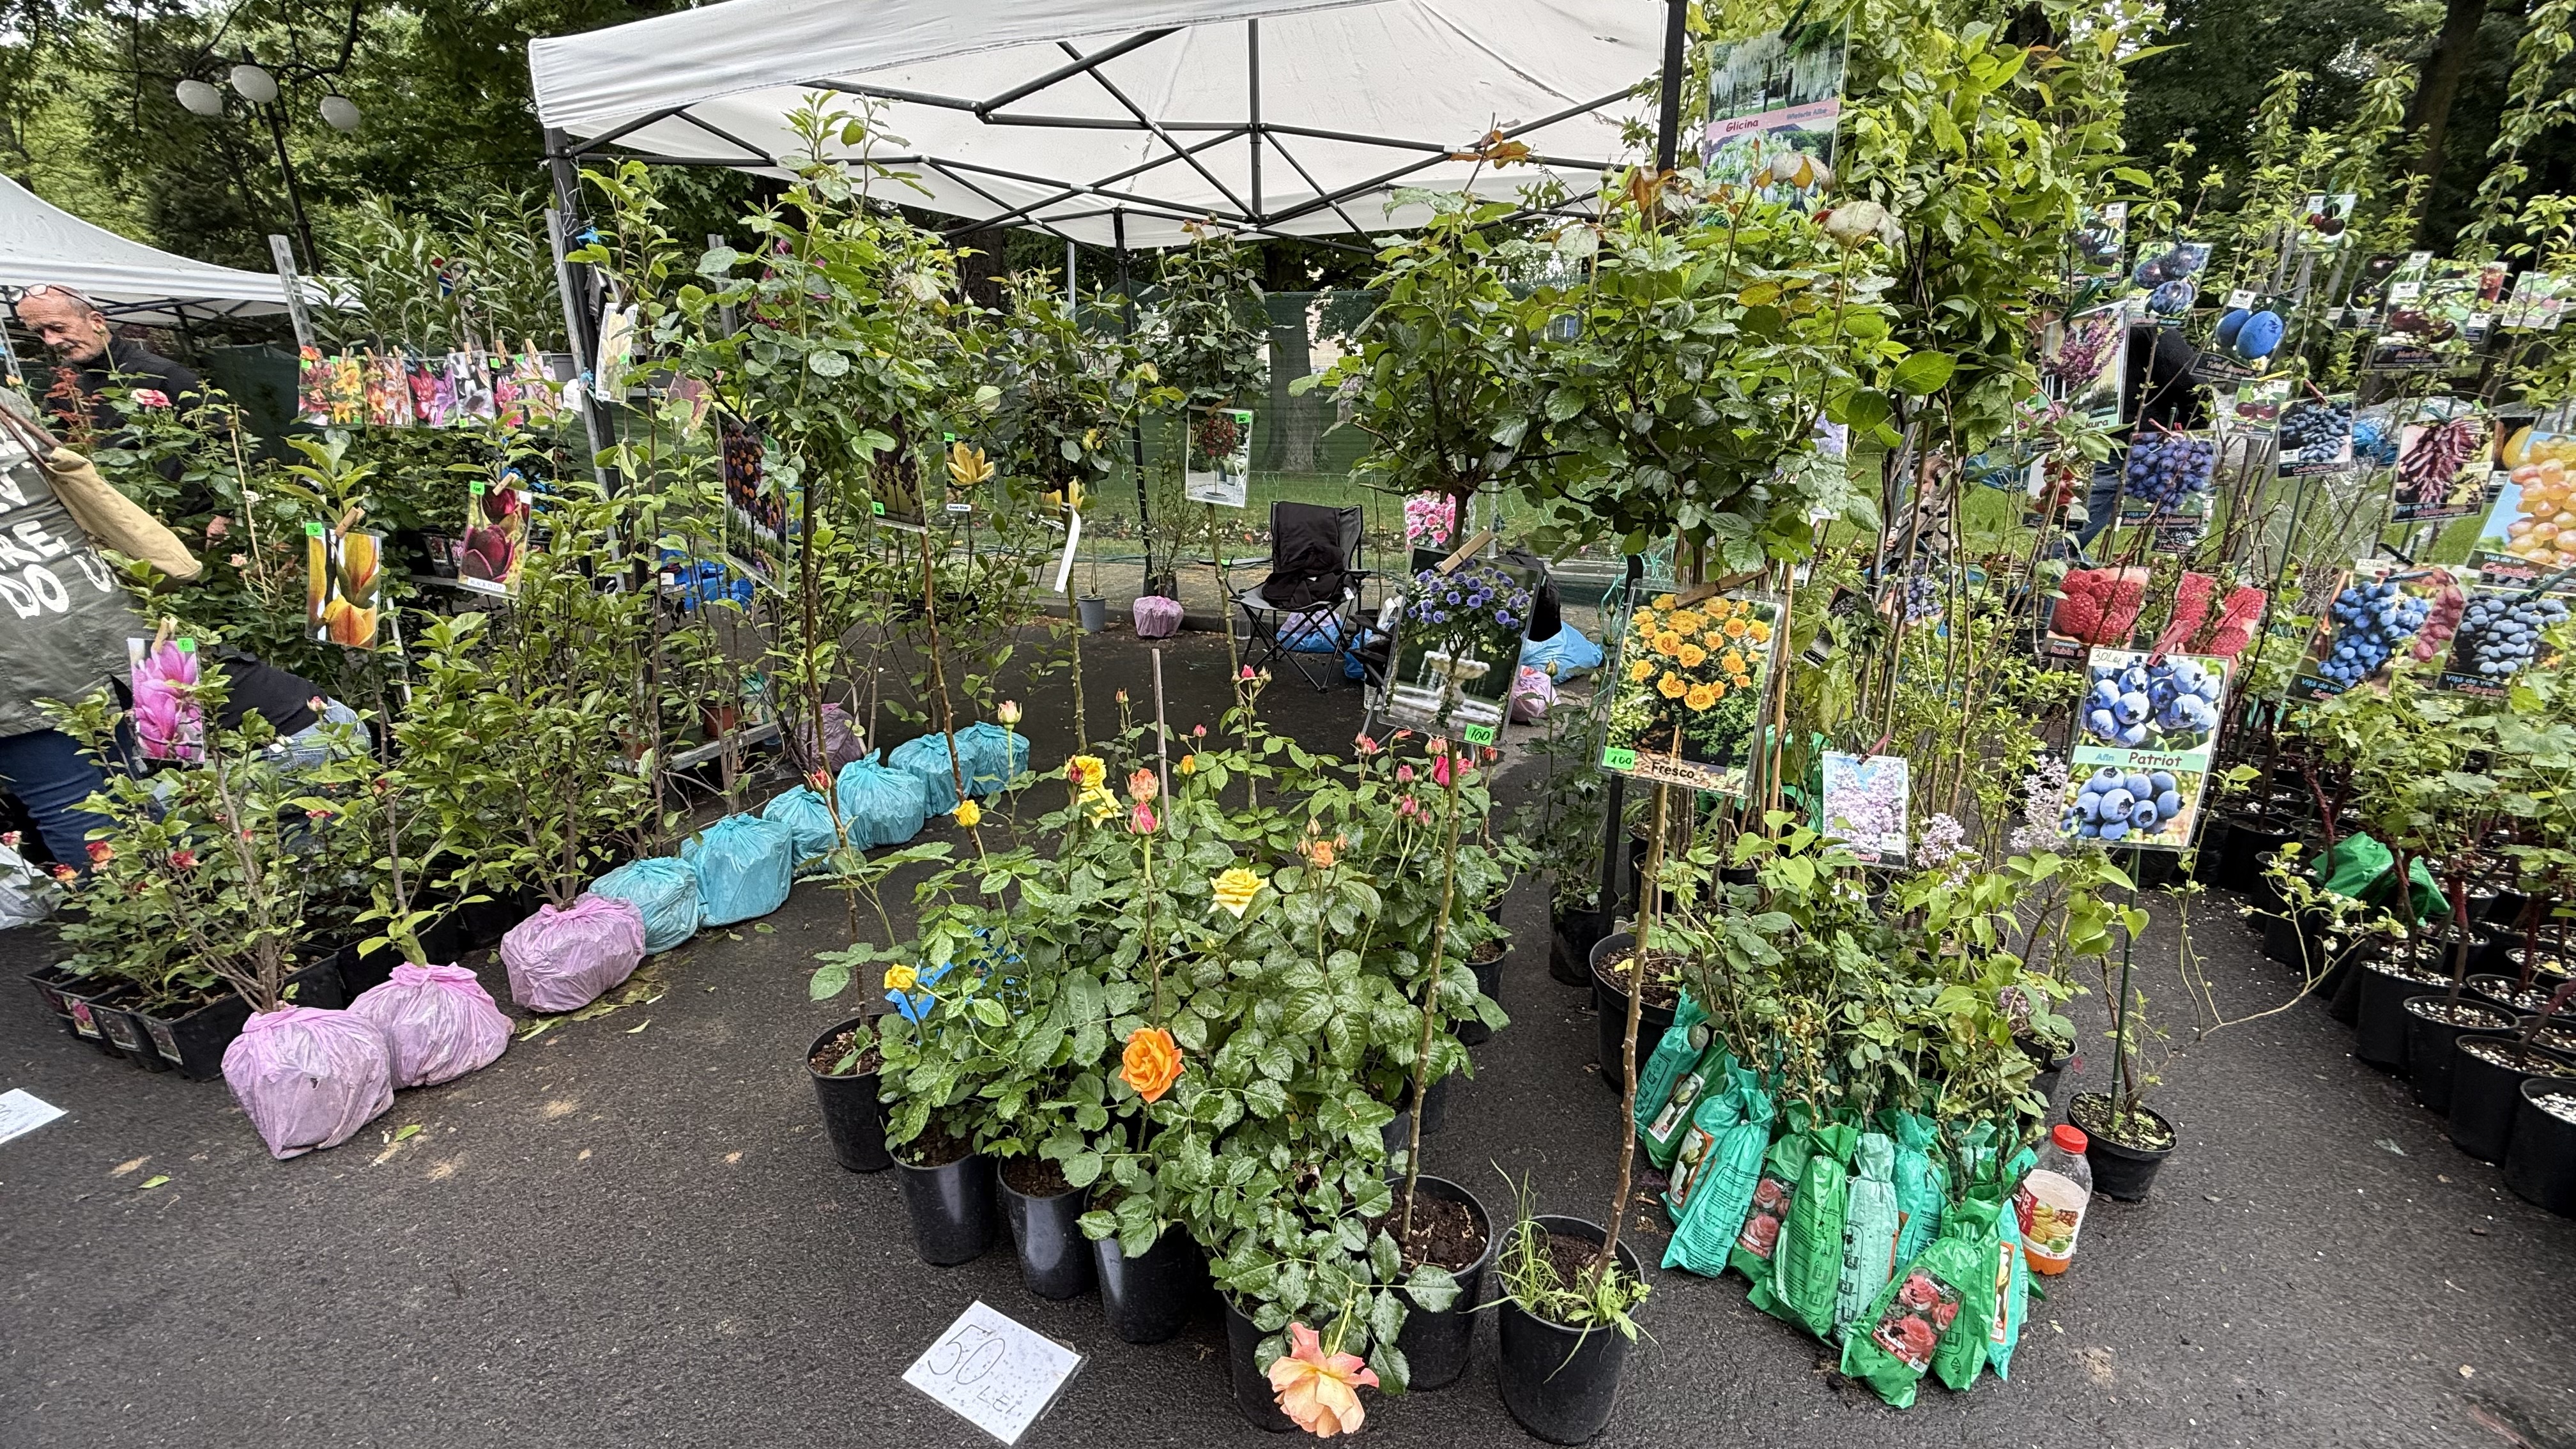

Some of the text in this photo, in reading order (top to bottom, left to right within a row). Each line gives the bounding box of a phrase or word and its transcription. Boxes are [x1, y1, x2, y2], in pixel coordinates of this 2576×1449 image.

[1726, 119, 1759, 132] Glicina
[1471, 728, 1491, 740] 100
[1611, 756, 1632, 765] 100
[2095, 751, 2182, 767] Afin Patriot
[1652, 762, 1695, 779] Fresco
[1854, 853, 1882, 864] eauty
[928, 1324, 1005, 1385] 50
[977, 1385, 1022, 1414] LEI
